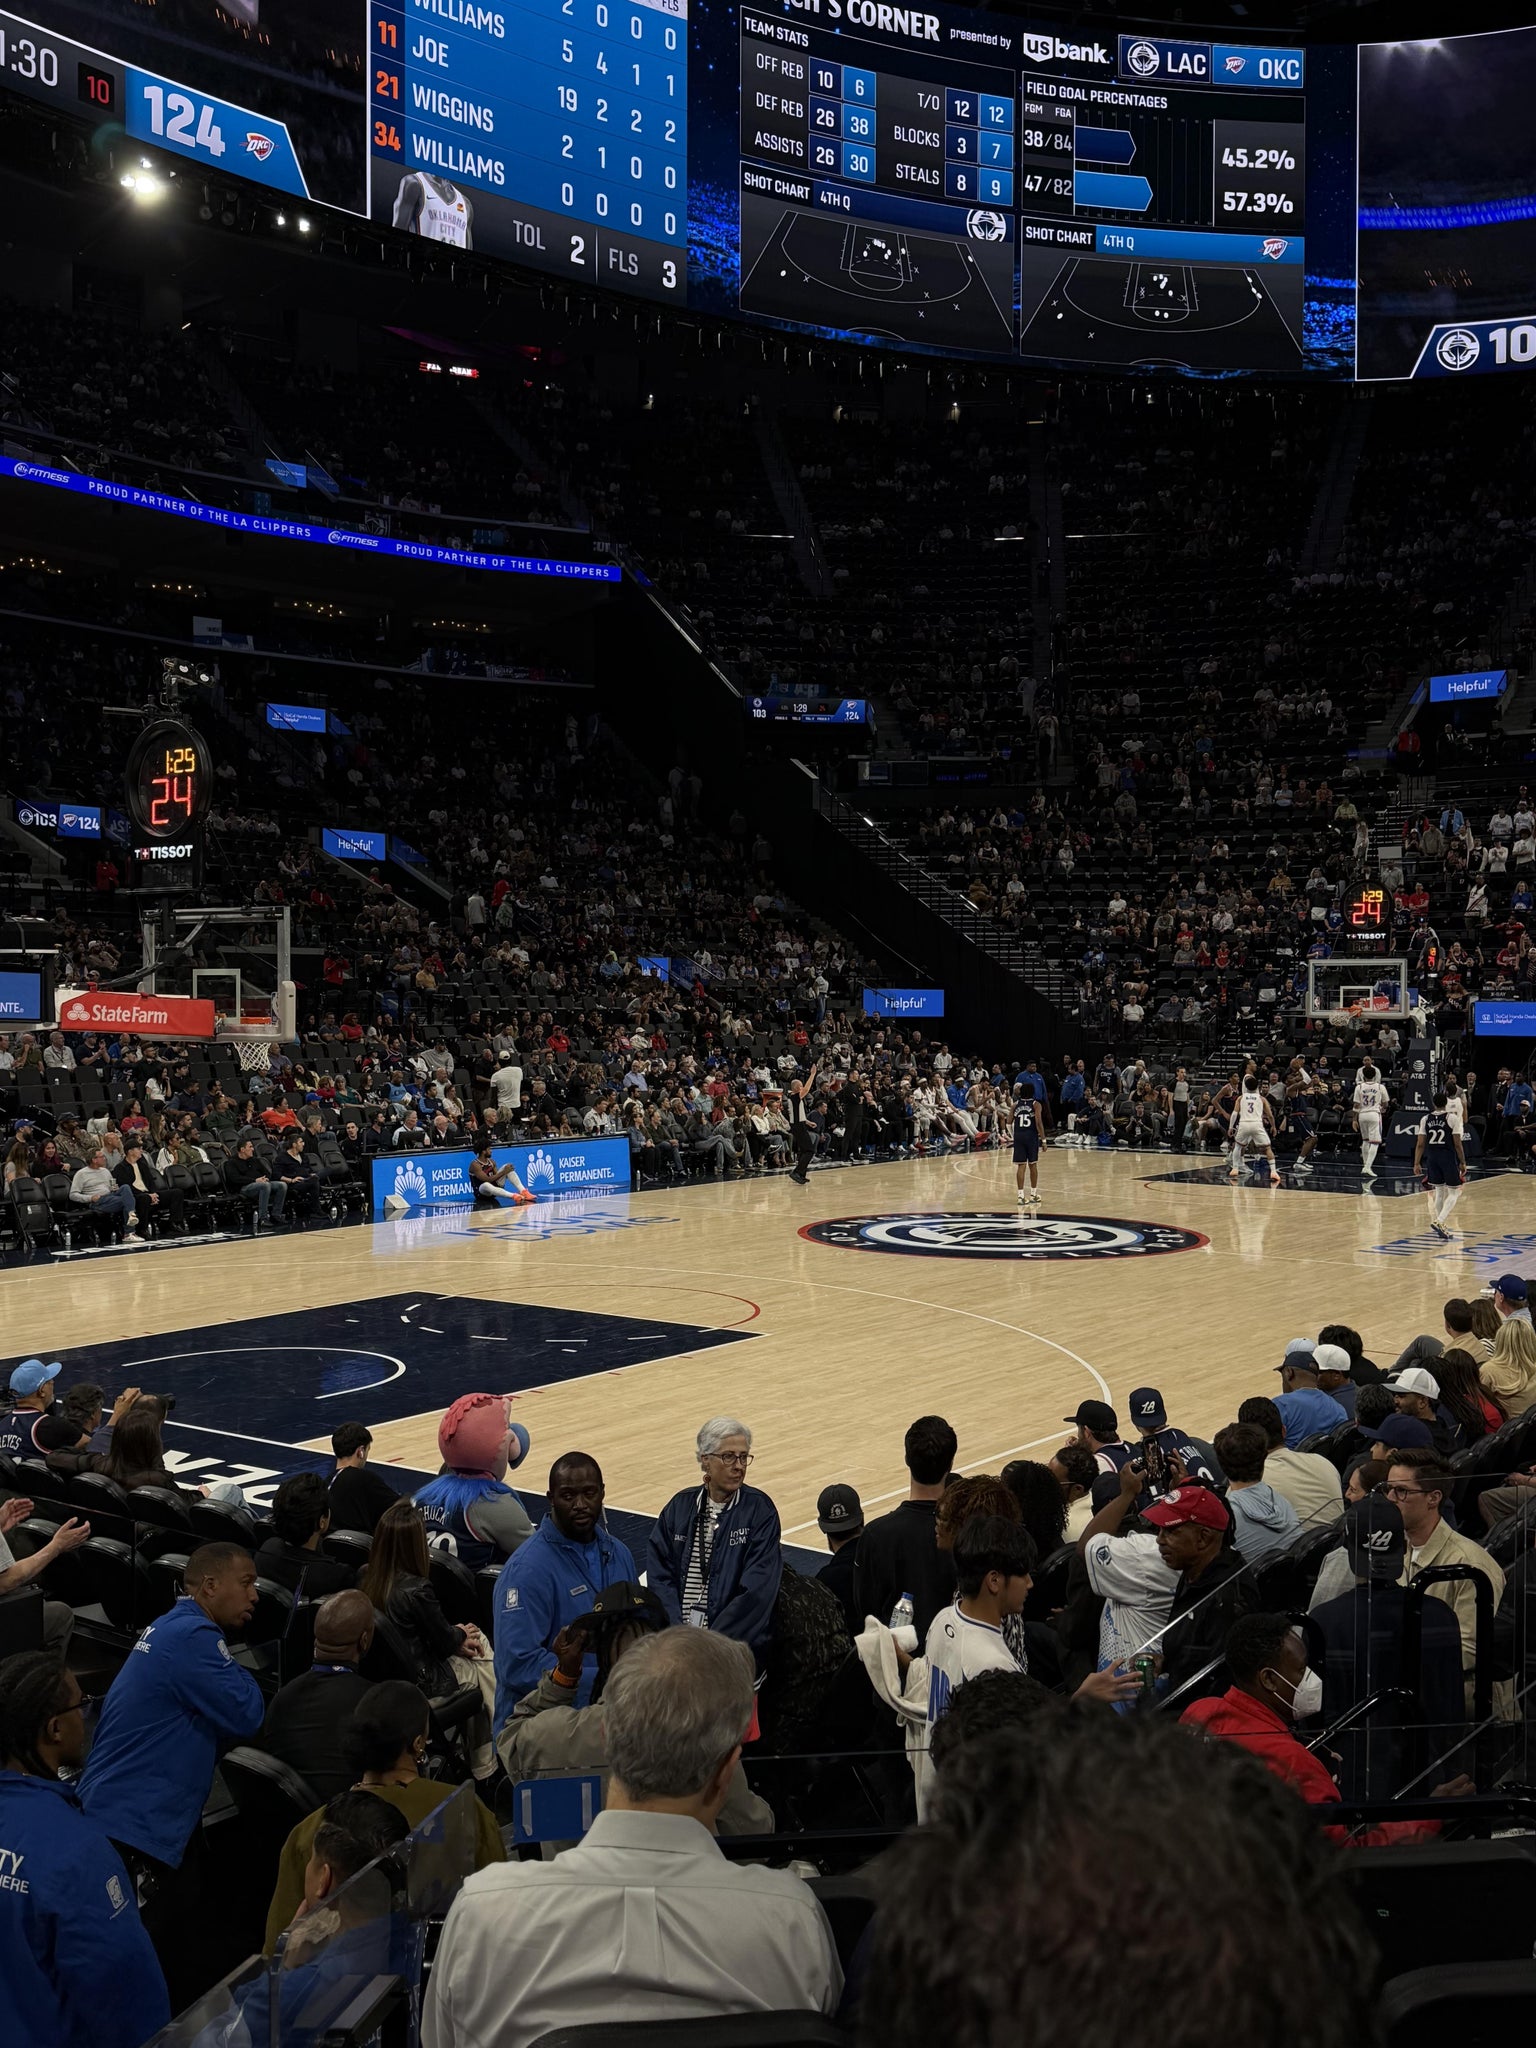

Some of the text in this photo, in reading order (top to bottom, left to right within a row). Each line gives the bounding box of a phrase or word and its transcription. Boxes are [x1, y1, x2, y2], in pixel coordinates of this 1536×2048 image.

[596, 5, 608, 28] 0
[630, 17, 642, 39] 0
[664, 28, 676, 50] 0
[744, 17, 809, 47] TEAM STATS
[847, 0, 941, 42] CORNER
[950, 28, 998, 46] presented
[1000, 35, 1012, 50] by
[562, 39, 574, 63] 5
[596, 52, 608, 75] 4
[632, 64, 640, 86] 1
[666, 75, 674, 97] 1
[756, 53, 865, 97] OFF REB 10 6
[1167, 53, 1207, 76] LAC
[1259, 58, 1300, 80] OKC
[87, 76, 109, 104] 10
[378, 20, 676, 143] 11 JOE 19 2 2 2
[1026, 82, 1168, 109] FIELD GOAL PERCENTAGES
[756, 92, 869, 136] DEF REB 26 38
[917, 93, 1005, 124] T/O 12 12
[1025, 103, 1043, 114] FGM
[1055, 107, 1072, 119] FGA
[144, 86, 226, 157] 124
[376, 71, 676, 189] 21 WIGGINS 2 1 0 0
[754, 131, 869, 173] ASSISTS 26 30
[894, 125, 1001, 160] BLOCKS 3 7
[1222, 148, 1296, 170] 45.2%
[374, 121, 676, 235] 34 WILLIAMS 0 0 0 0
[896, 163, 1001, 197] STEALS 8 9
[744, 172, 851, 210] SHOT CHART 4TH Q
[1223, 192, 1294, 214] 57.3%
[1026, 226, 1135, 250] SHOT CHART 4TH Q
[513, 220, 677, 289] TOL 2 FLS 3
[28, 468, 70, 483] FITNESS
[89, 482, 129, 499] PROUD
[133, 492, 186, 513] PARTNER
[190, 506, 204, 517] OF
[208, 510, 229, 523] THE
[233, 516, 247, 527] LA
[253, 520, 312, 538] CLIPPERS
[341, 534, 379, 547] FITNESS
[396, 543, 433, 558] PROUD
[438, 550, 487, 566] PARTNER
[492, 558, 506, 567] OF
[511, 560, 532, 570] THE
[537, 562, 551, 572] LA
[556, 565, 610, 578] CLIPPERS
[1448, 679, 1489, 695] Helpful
[753, 709, 766, 719] 103
[793, 703, 808, 713] 1:29
[845, 711, 860, 720] 124
[152, 776, 191, 825] 24
[34, 813, 100, 831] 103 124
[150, 845, 193, 860] TISSOT
[338, 838, 372, 853] Helpful
[1362, 890, 1383, 902] 1:29
[1352, 903, 1381, 925] 24
[1247, 1102, 1254, 1114] 3
[1362, 1096, 1376, 1107] 34
[1018, 1114, 1032, 1127] 15
[1429, 1129, 1446, 1145] 22
[559, 1156, 585, 1169] KAISER
[432, 1168, 463, 1181] KAISER
[559, 1167, 613, 1183] PERMANENTE
[433, 1182, 474, 1197] PERMAN
[1141, 1401, 1155, 1414] LA
[418, 1505, 450, 1525] HUCK
[1367, 1529, 1393, 1552] LA
